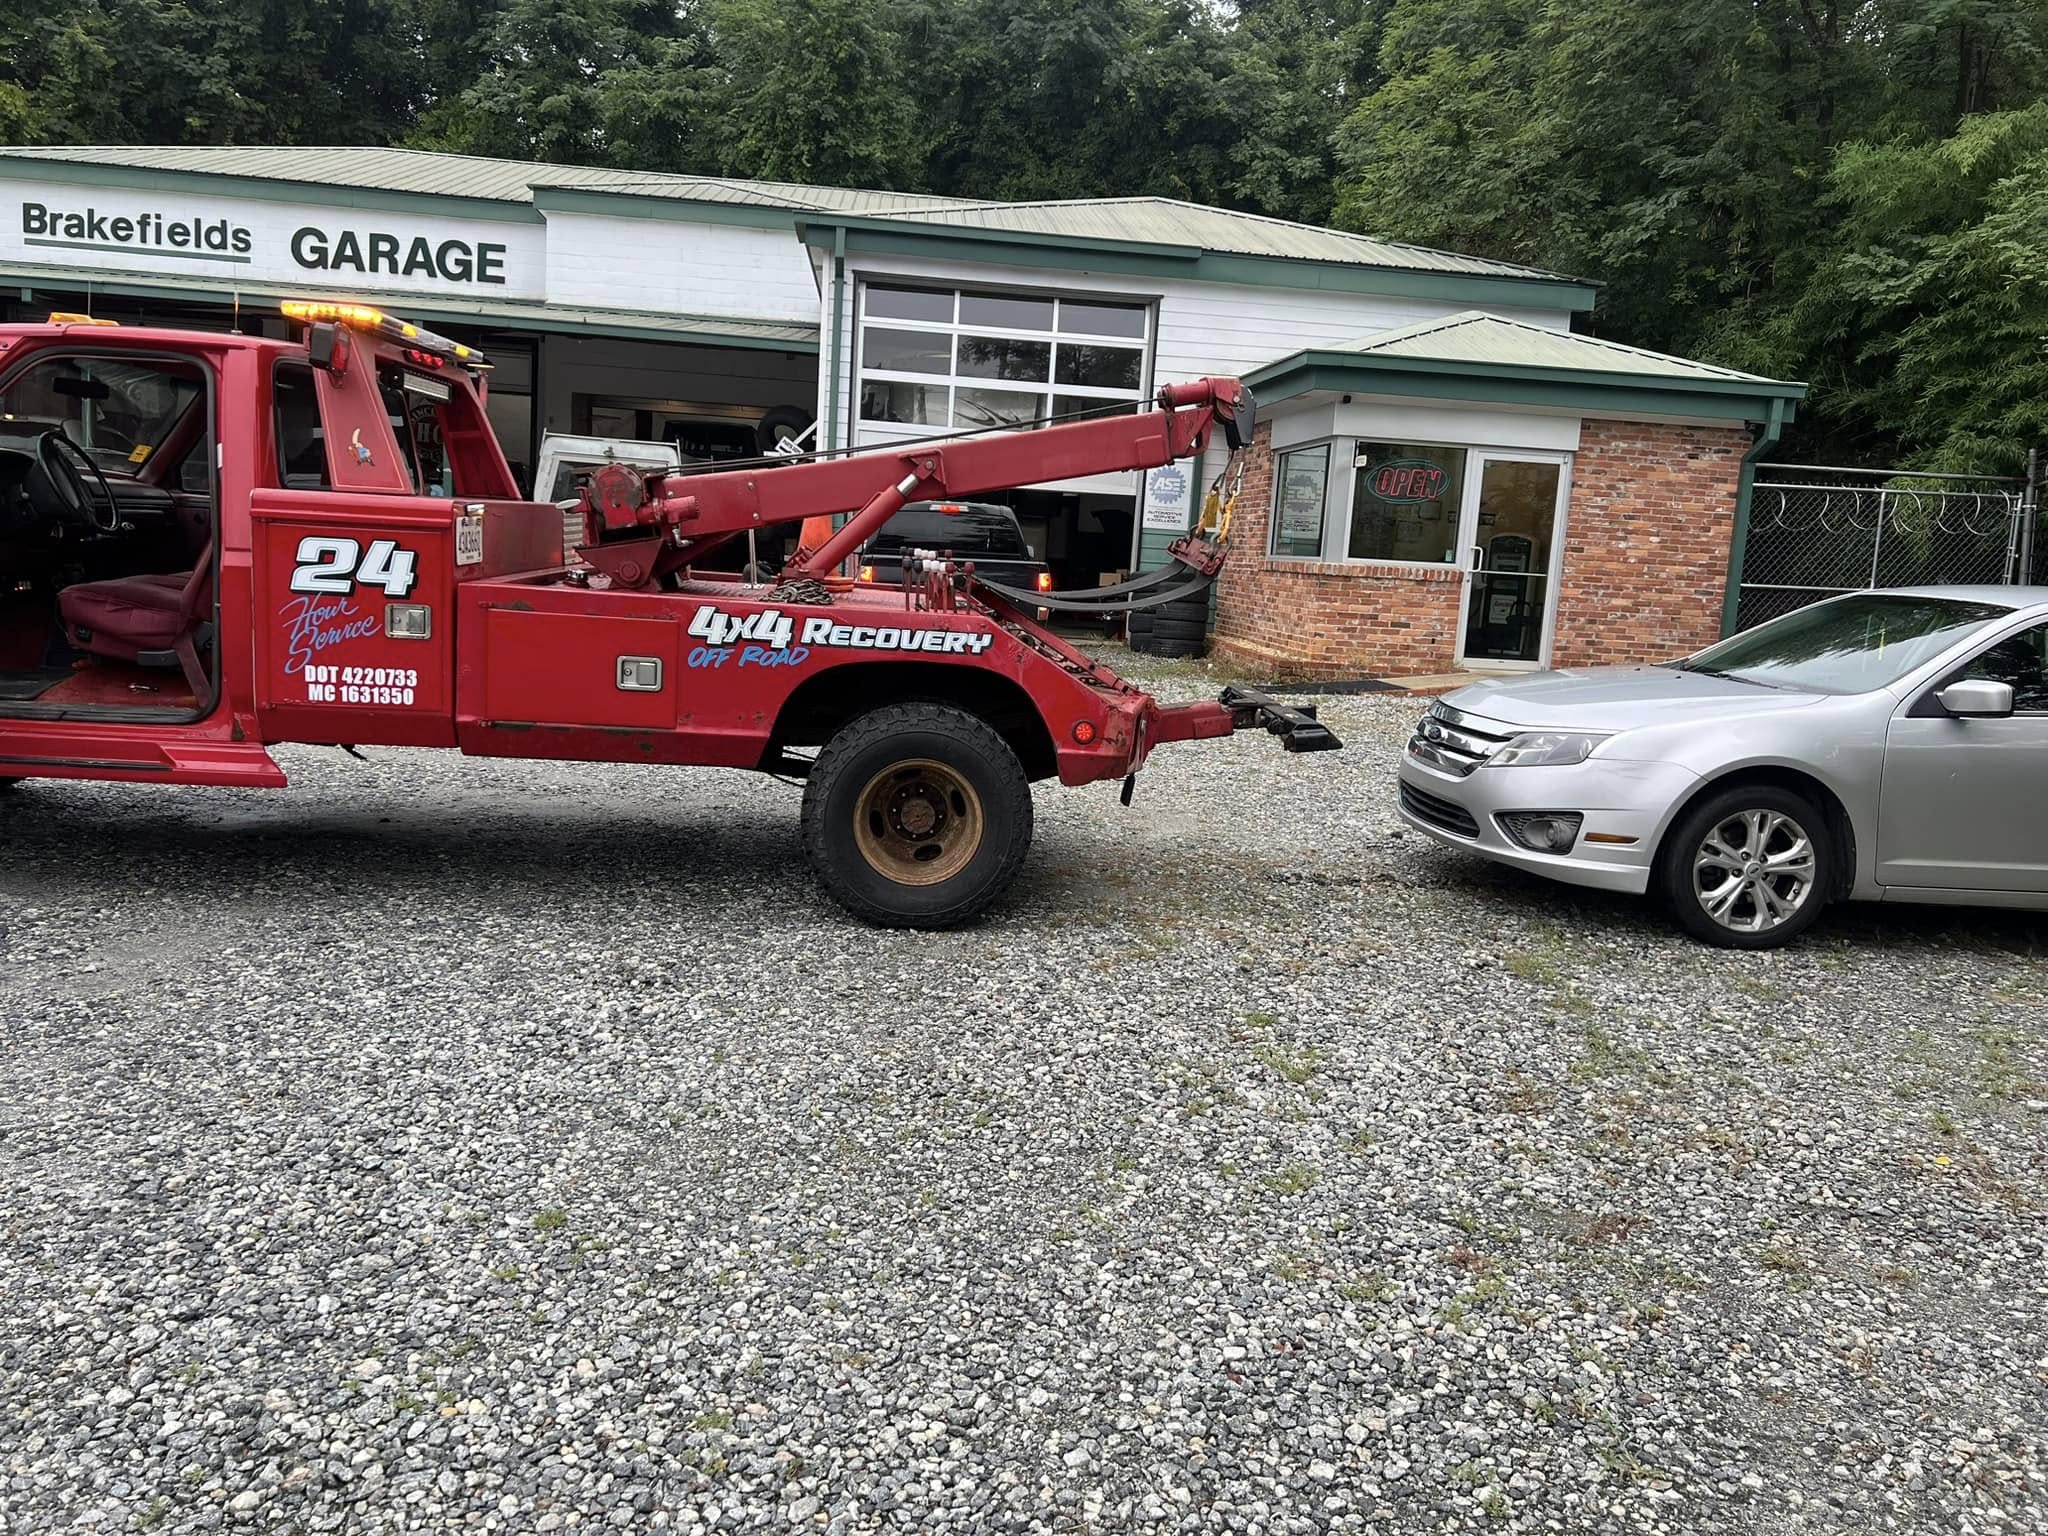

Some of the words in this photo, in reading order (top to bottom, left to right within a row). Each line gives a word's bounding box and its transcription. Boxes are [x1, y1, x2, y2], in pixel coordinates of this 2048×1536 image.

[22, 202, 252, 253] Brakefields
[290, 225, 507, 285] GARAGE
[1153, 476, 1181, 492] ASE
[1375, 467, 1442, 499] OPEN
[289, 535, 421, 598] 24
[278, 592, 360, 641] Hour
[283, 614, 384, 674] Service
[801, 617, 994, 655] RECOVERY
[687, 647, 736, 669] OFF
[738, 646, 810, 668] ROAD
[304, 665, 339, 684] DOT
[341, 666, 418, 687] 4220733
[308, 684, 337, 702] MC
[339, 685, 414, 705] 1631350
